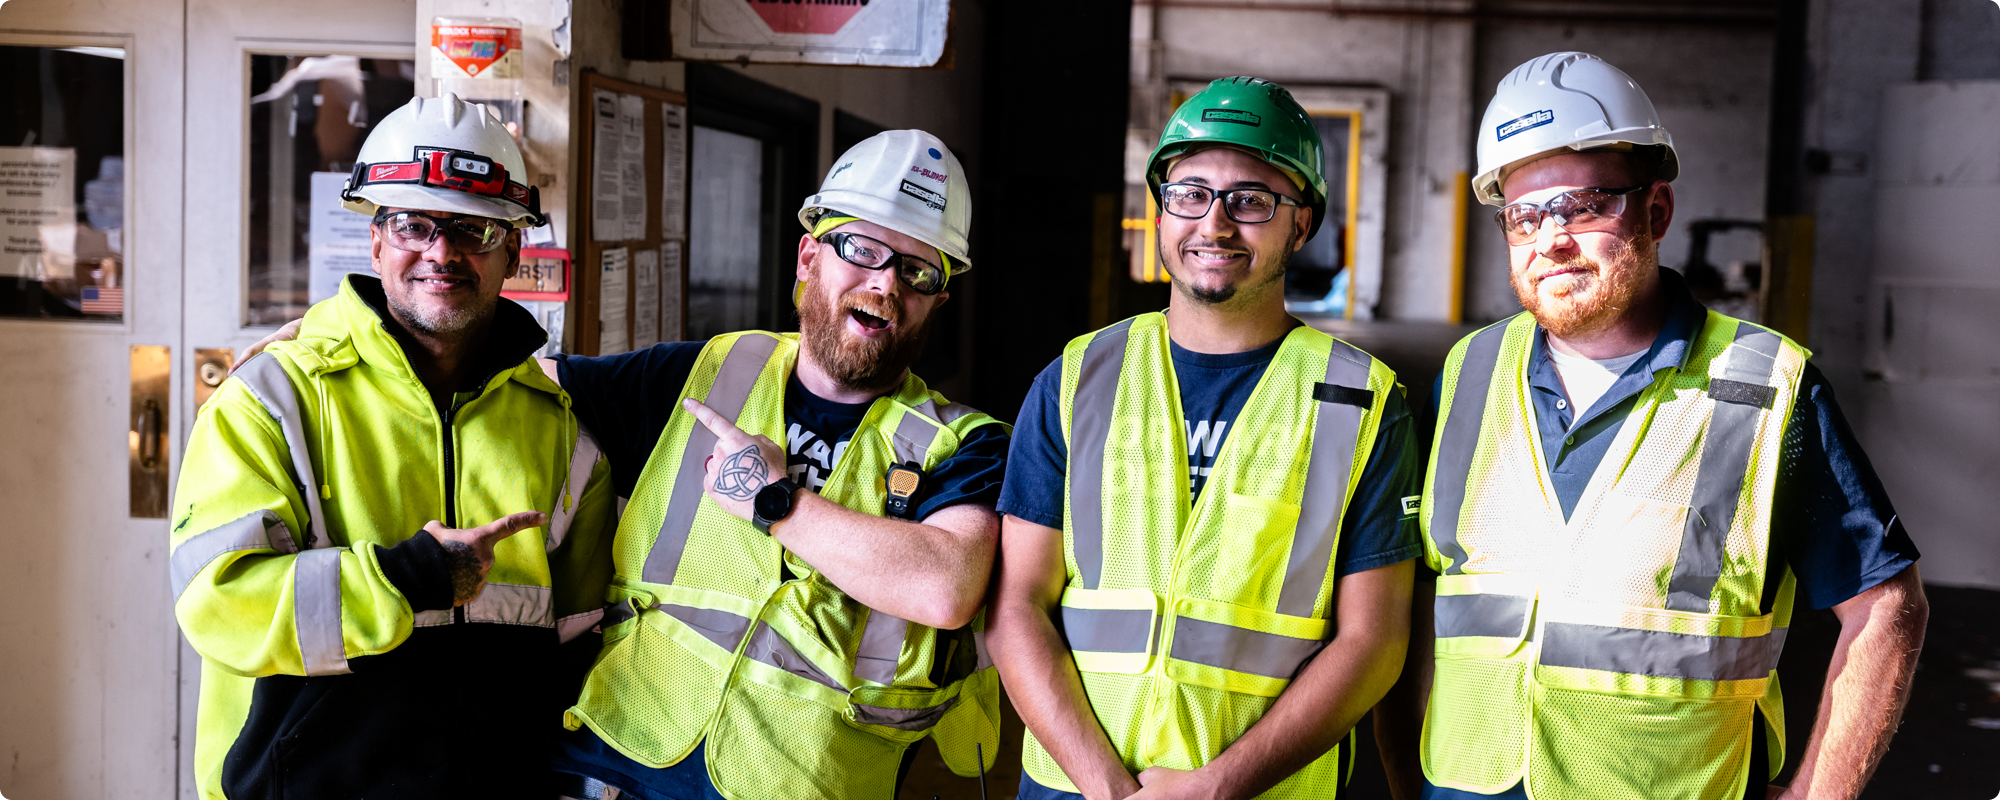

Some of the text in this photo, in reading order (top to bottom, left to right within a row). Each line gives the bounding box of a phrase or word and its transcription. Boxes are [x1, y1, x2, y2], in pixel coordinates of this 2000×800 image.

[1204, 111, 1260, 125] casella
[1499, 111, 1553, 138] casella
[902, 182, 947, 207] casella
[513, 264, 556, 280] RST
[787, 463, 828, 492] TH
